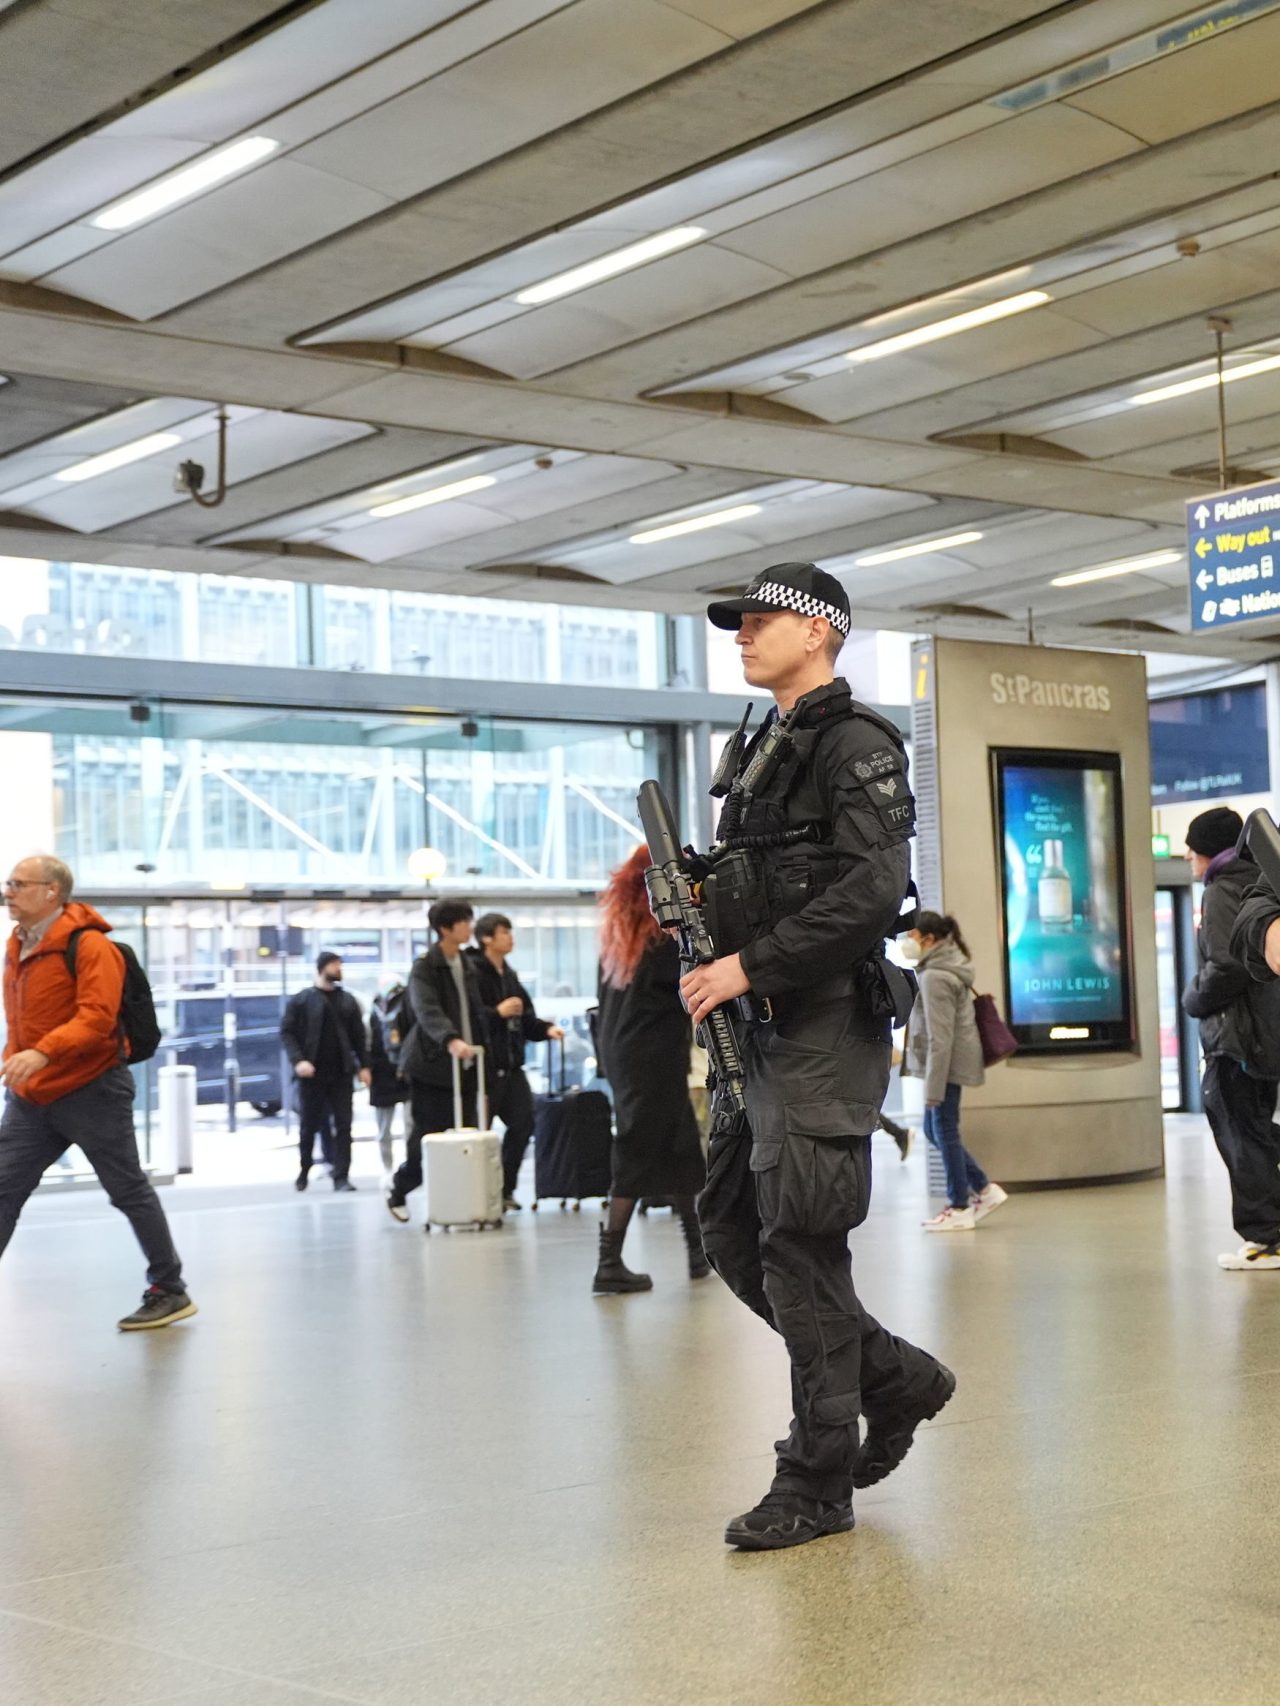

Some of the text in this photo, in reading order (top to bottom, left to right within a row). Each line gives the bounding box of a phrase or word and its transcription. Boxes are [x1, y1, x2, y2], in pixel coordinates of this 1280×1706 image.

[1216, 533, 1246, 553] Way
[1246, 525, 1271, 547] out
[1216, 563, 1259, 587] Buses
[870, 755, 894, 768] POLICE
[888, 805, 909, 822] TFC
[1024, 976, 1110, 993] JOHN LEWIS
